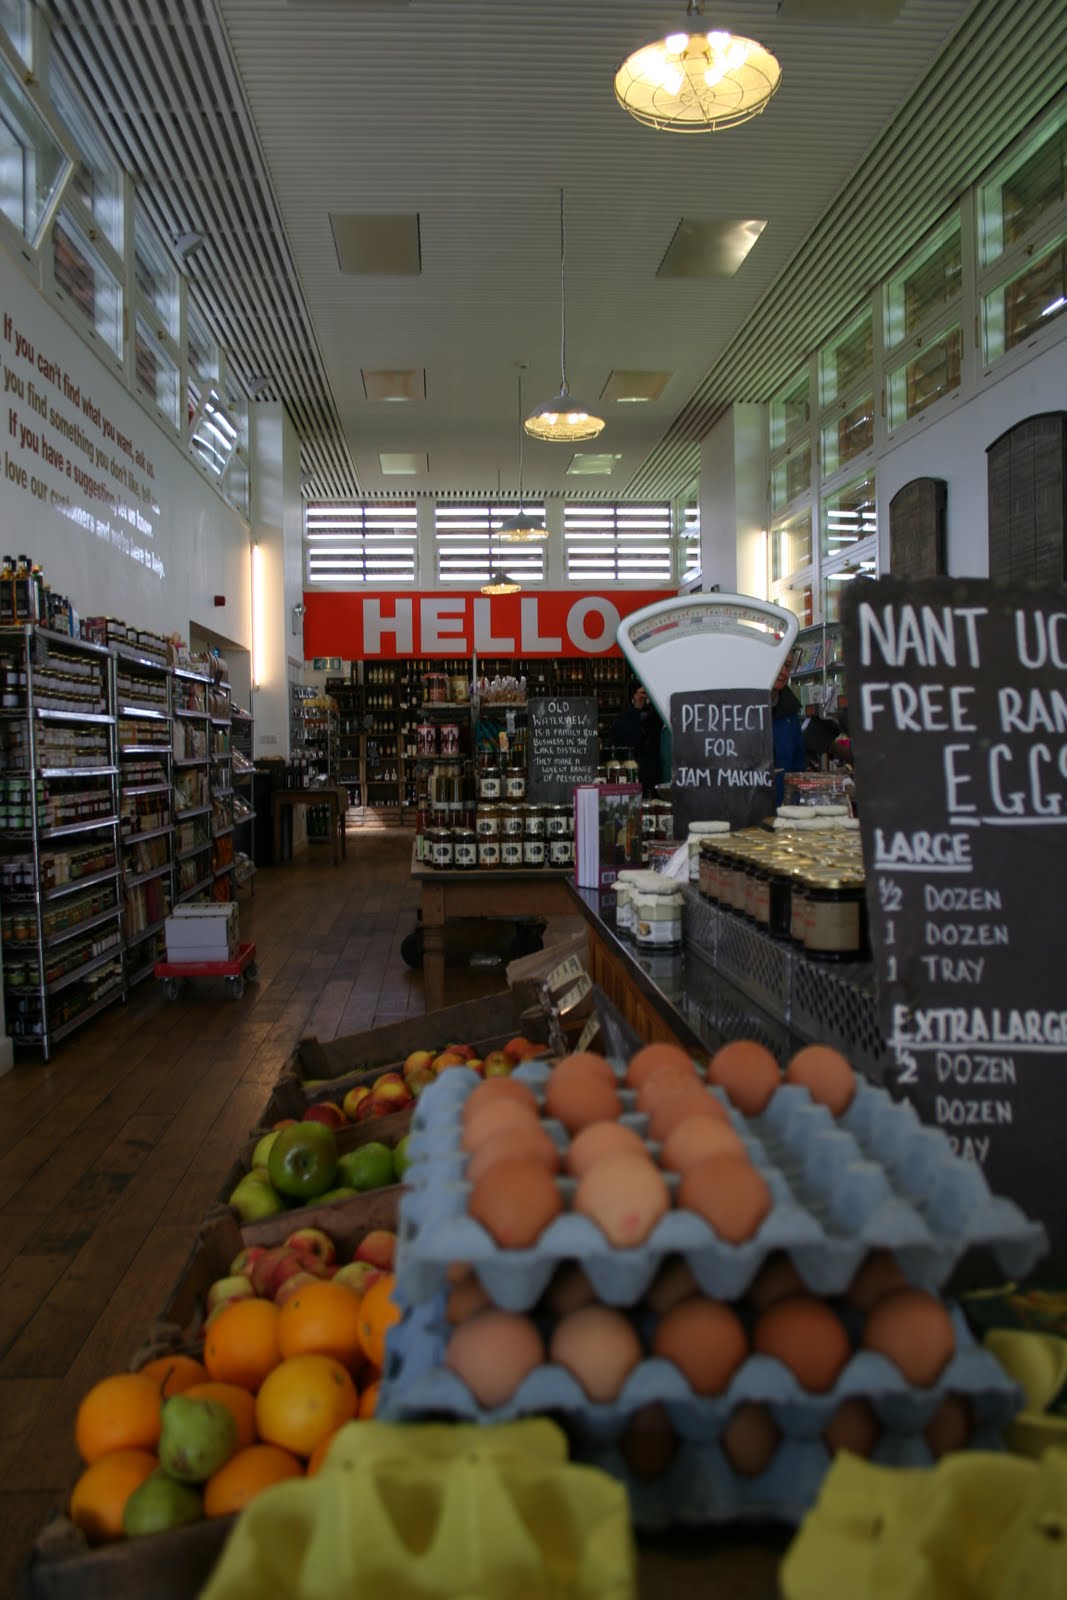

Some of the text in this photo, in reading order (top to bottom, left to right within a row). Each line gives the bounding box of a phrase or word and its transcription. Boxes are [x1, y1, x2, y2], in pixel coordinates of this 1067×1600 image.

[4, 312, 12, 343] If
[15, 330, 34, 365] you
[37, 353, 61, 391] can't
[63, 372, 80, 408] find
[82, 396, 101, 428] what
[103, 416, 115, 442] you
[135, 449, 145, 471] ask
[5, 365, 24, 400] you
[27, 381, 47, 420] find
[49, 407, 94, 464] something
[96, 447, 108, 472] you
[110, 456, 127, 488] don't
[9, 407, 17, 438] If
[20, 423, 39, 454] you
[42, 433, 64, 472] have
[66, 459, 71, 478] a
[118, 494, 127, 520] let
[128, 506, 136, 526] us
[5, 450, 28, 489] love
[31, 475, 48, 502] our
[96, 519, 110, 541] and
[130, 537, 145, 565] here
[145, 548, 152, 569] to
[363, 596, 621, 654] HELLO
[859, 602, 988, 669] NANT
[548, 702, 570, 713] OLD
[682, 704, 769, 733] PERFECT
[861, 683, 976, 733] FREE
[532, 737, 588, 747] BUSINESS IN THE
[535, 728, 598, 738] IS A FAMILY RUN
[705, 738, 738, 757] FOR
[533, 757, 552, 766] THEY
[553, 758, 572, 766] MAKE
[534, 746, 554, 755] LAKE
[542, 765, 592, 774] LOVELY RANGE
[543, 774, 552, 782] OF
[676, 767, 773, 788] JAM MAKING
[874, 829, 971, 864] LARGE
[924, 884, 1002, 911] DOZEN
[885, 919, 1009, 945] 1 DOZEN
[888, 954, 985, 983] 1 TRAY
[936, 1051, 1017, 1085] DOZEN
[935, 1094, 1013, 1126] DOZEN
